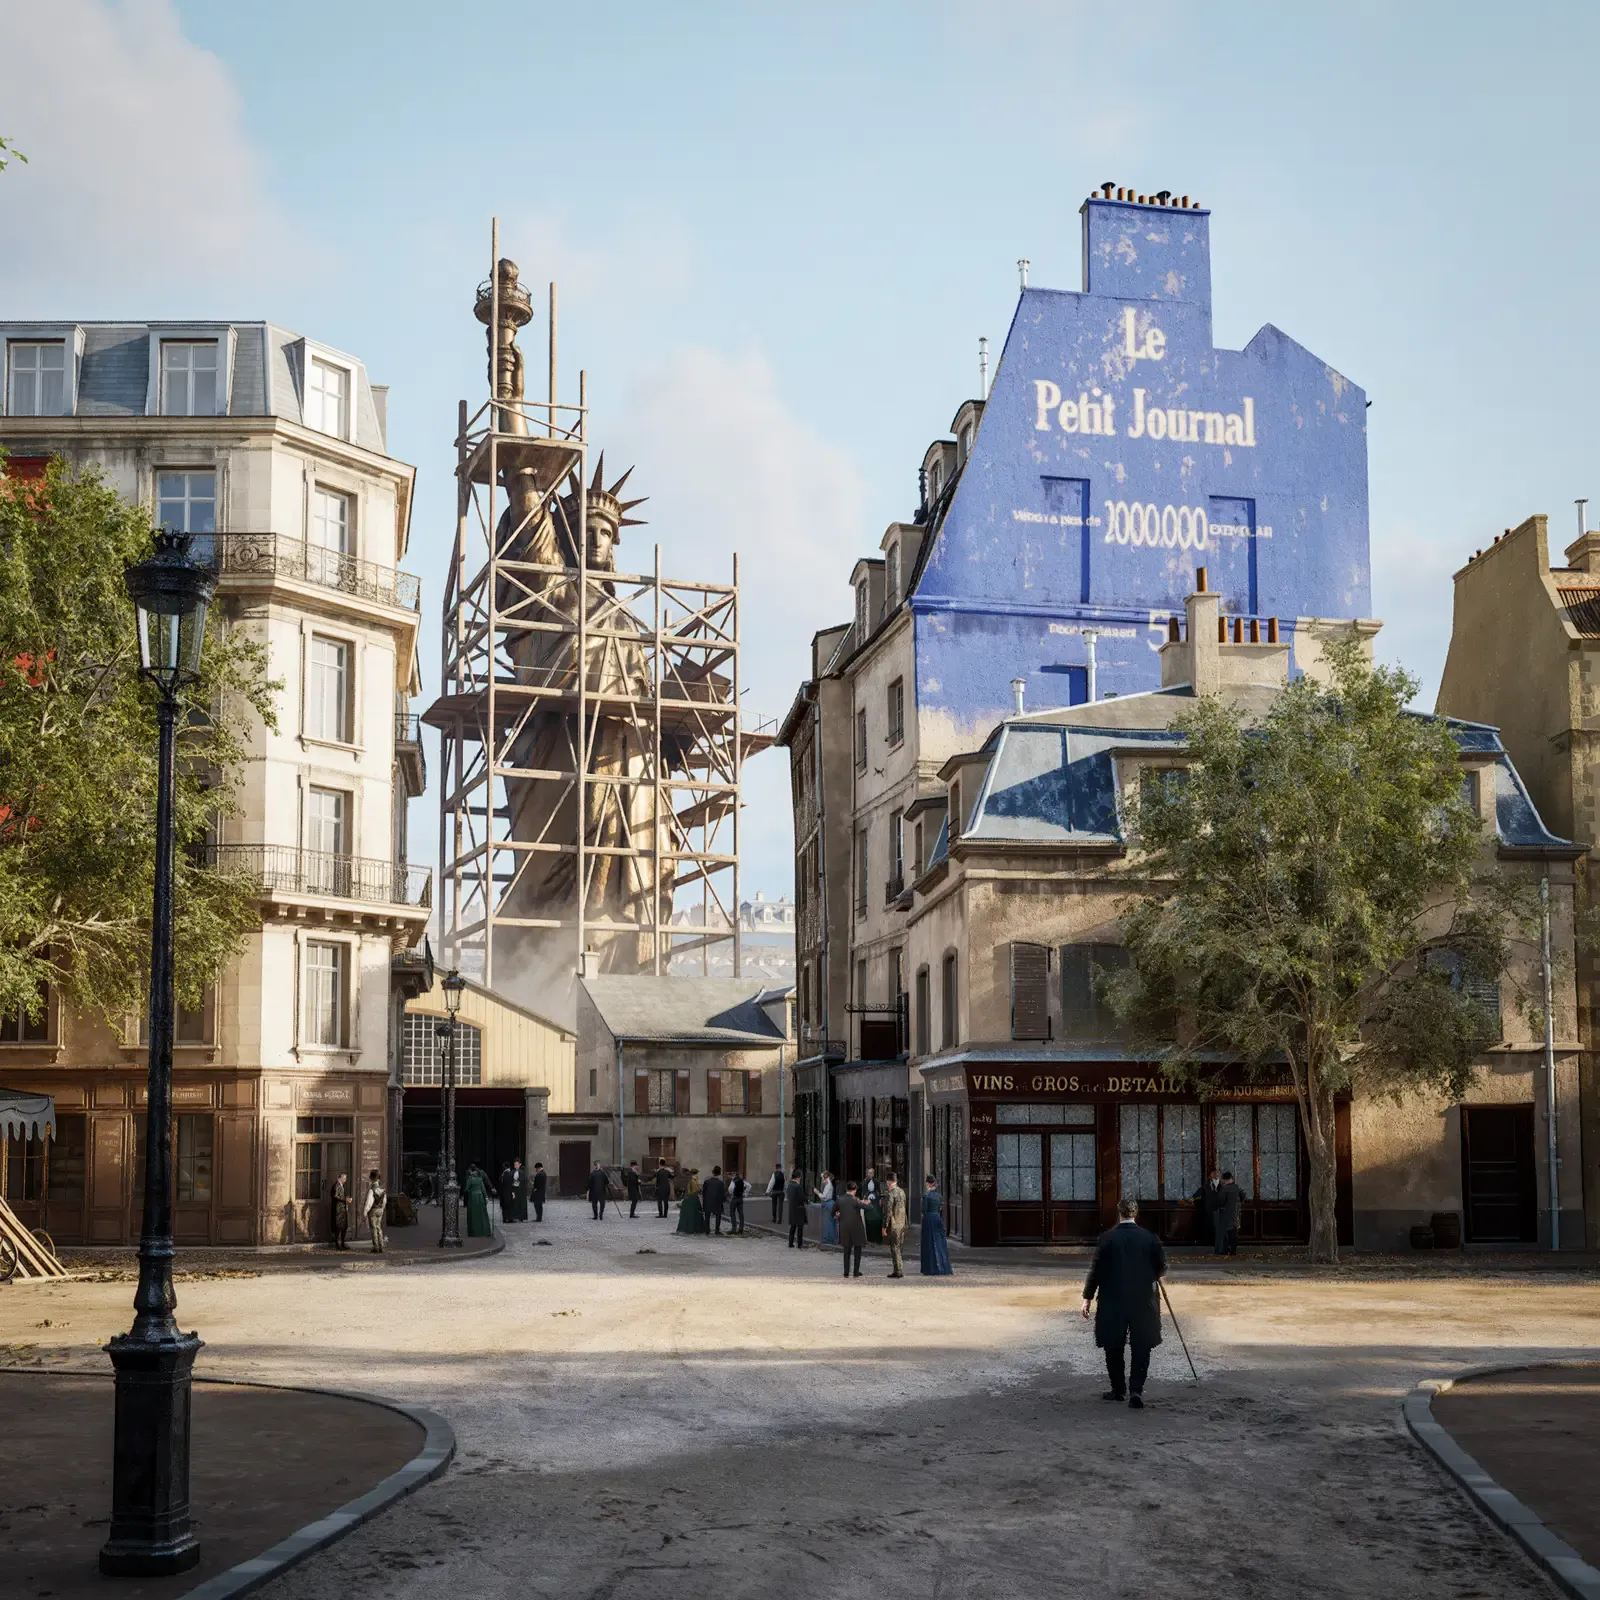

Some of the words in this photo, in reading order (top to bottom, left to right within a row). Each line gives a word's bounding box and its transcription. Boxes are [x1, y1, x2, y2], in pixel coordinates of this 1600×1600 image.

[1123, 307, 1166, 360] Le
[1033, 380, 1116, 436] Petit
[1128, 388, 1257, 447] Journal
[972, 1075, 1014, 1091] VINS
[1031, 1075, 1079, 1092] GROS
